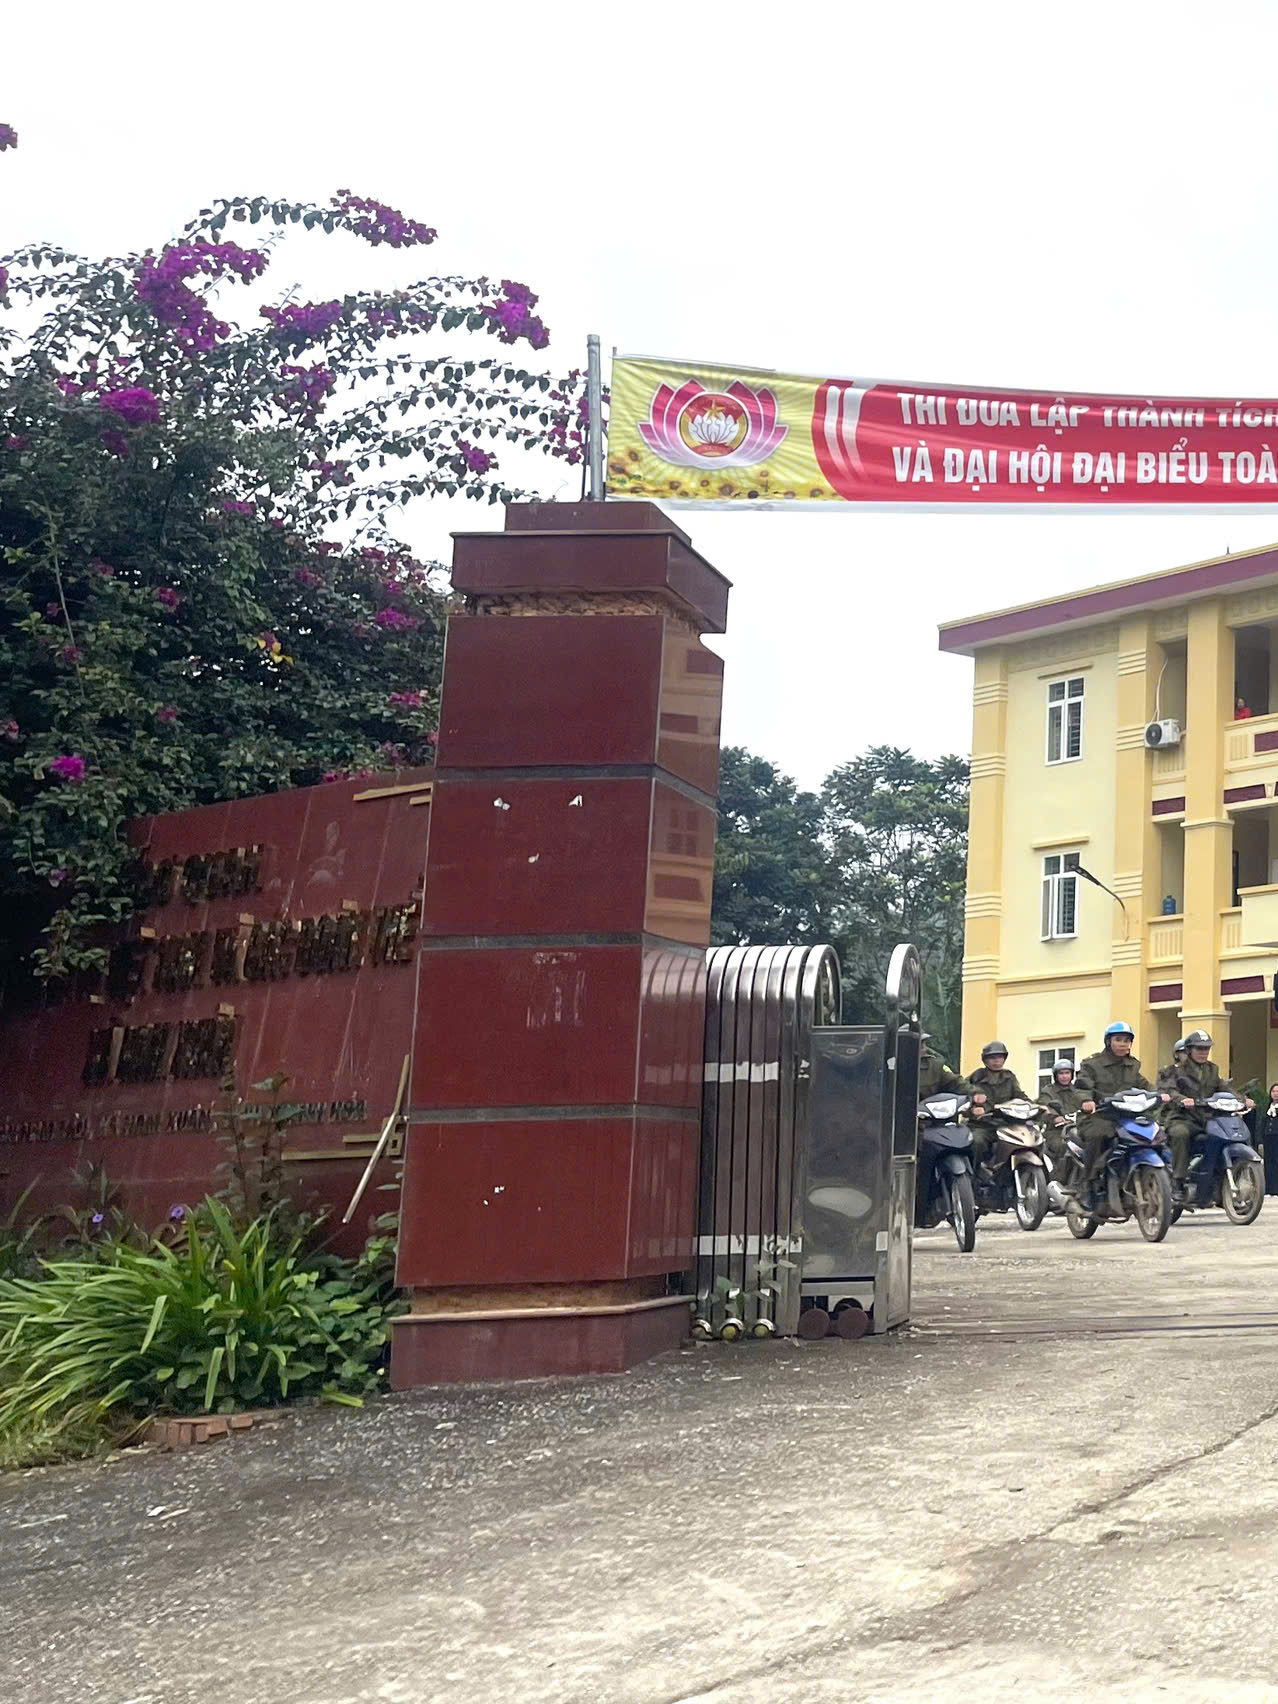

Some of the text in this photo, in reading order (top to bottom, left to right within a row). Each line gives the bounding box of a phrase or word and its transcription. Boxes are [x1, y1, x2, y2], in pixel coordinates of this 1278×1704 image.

[896, 393, 948, 426] THI
[956, 398, 1021, 427] ĐUA
[1030, 397, 1090, 435] LẬP
[1101, 400, 1205, 428] THÀNH
[891, 440, 934, 483] VÀ
[943, 447, 998, 492] ĐẠI
[1008, 444, 1063, 492] HỘI
[1072, 451, 1125, 492] ĐẠI
[1136, 437, 1208, 485] BIỂU
